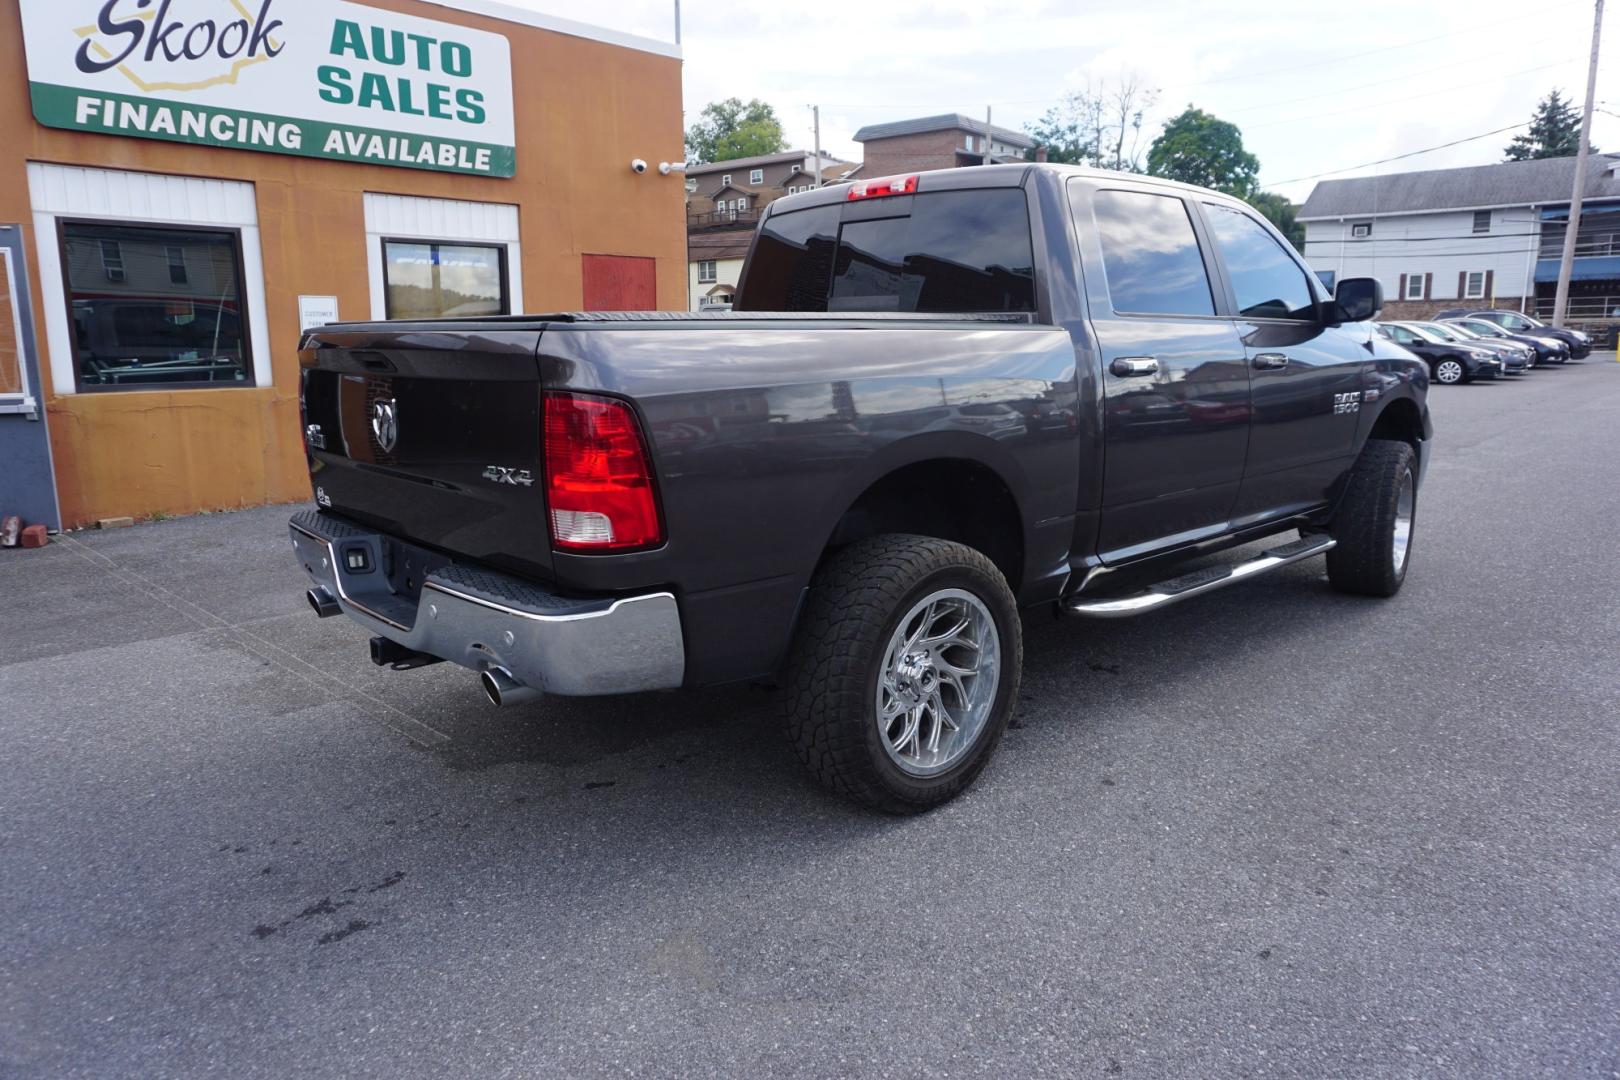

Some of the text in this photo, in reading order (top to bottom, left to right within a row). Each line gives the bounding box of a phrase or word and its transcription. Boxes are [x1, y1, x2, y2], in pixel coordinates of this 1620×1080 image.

[75, 0, 286, 73] Skook
[330, 18, 472, 78] AUTO
[317, 64, 486, 124] SALES
[75, 96, 491, 171] FINANCING AVAILABLE
[1334, 391, 1361, 403] RAM
[1334, 402, 1360, 415] 1500
